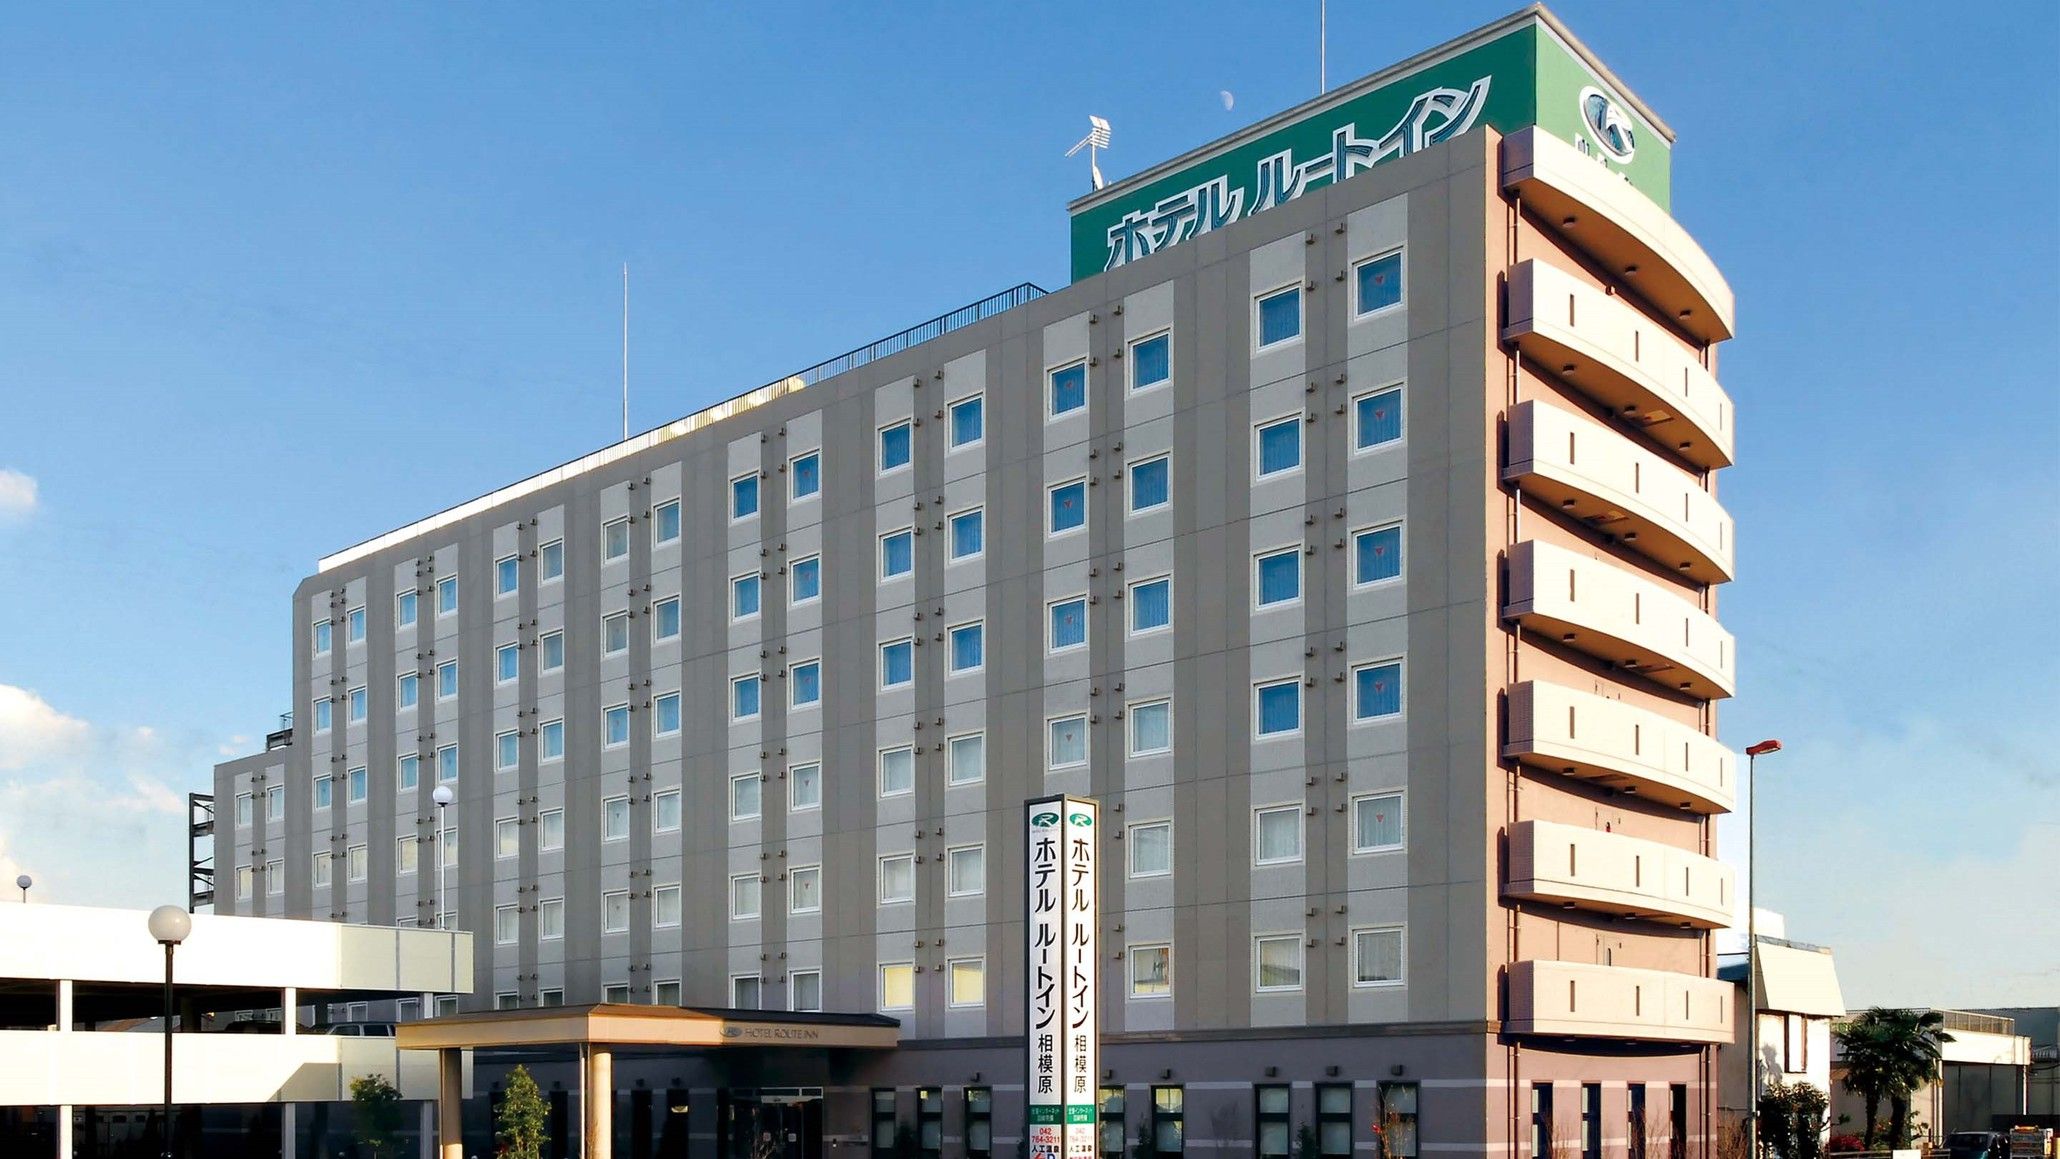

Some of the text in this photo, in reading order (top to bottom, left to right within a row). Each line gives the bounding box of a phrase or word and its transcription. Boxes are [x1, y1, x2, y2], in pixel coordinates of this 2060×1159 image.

[1104, 175, 1245, 271] ホテル
[1249, 75, 1491, 216] ルートイン
[1034, 837, 1057, 913] ホテル
[1071, 838, 1090, 912] ホテル
[1034, 923, 1057, 1030] ルートイン
[1071, 923, 1090, 1029] ルートイン
[745, 1028, 818, 1039] HOTEL ROUTE INN
[1037, 1033, 1053, 1094] 相模原
[1074, 1034, 1087, 1094] 相模原
[1039, 1127, 1052, 1135] 042
